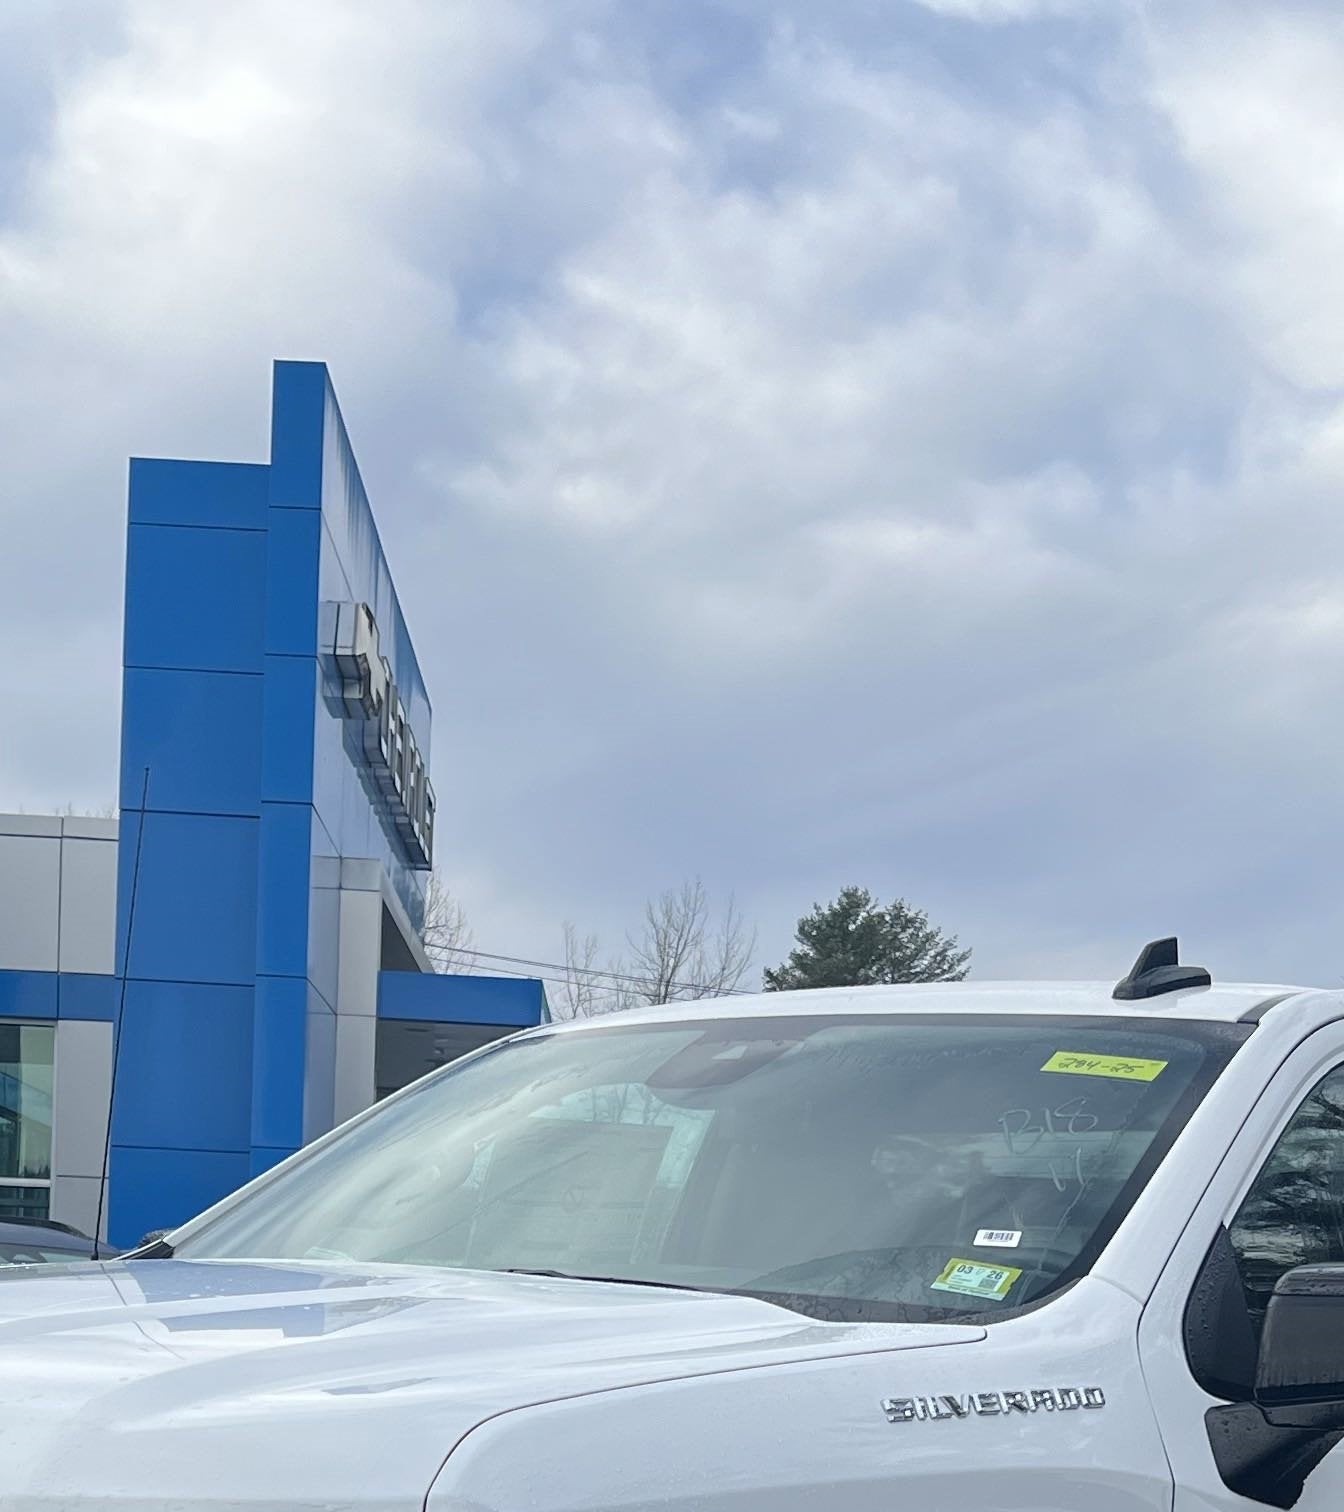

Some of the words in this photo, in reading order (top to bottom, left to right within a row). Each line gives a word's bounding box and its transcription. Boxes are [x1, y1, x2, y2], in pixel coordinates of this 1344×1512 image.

[956, 1264, 974, 1275] 03
[986, 1270, 1004, 1280] 26
[881, 1386, 1106, 1423] SILVERADO
